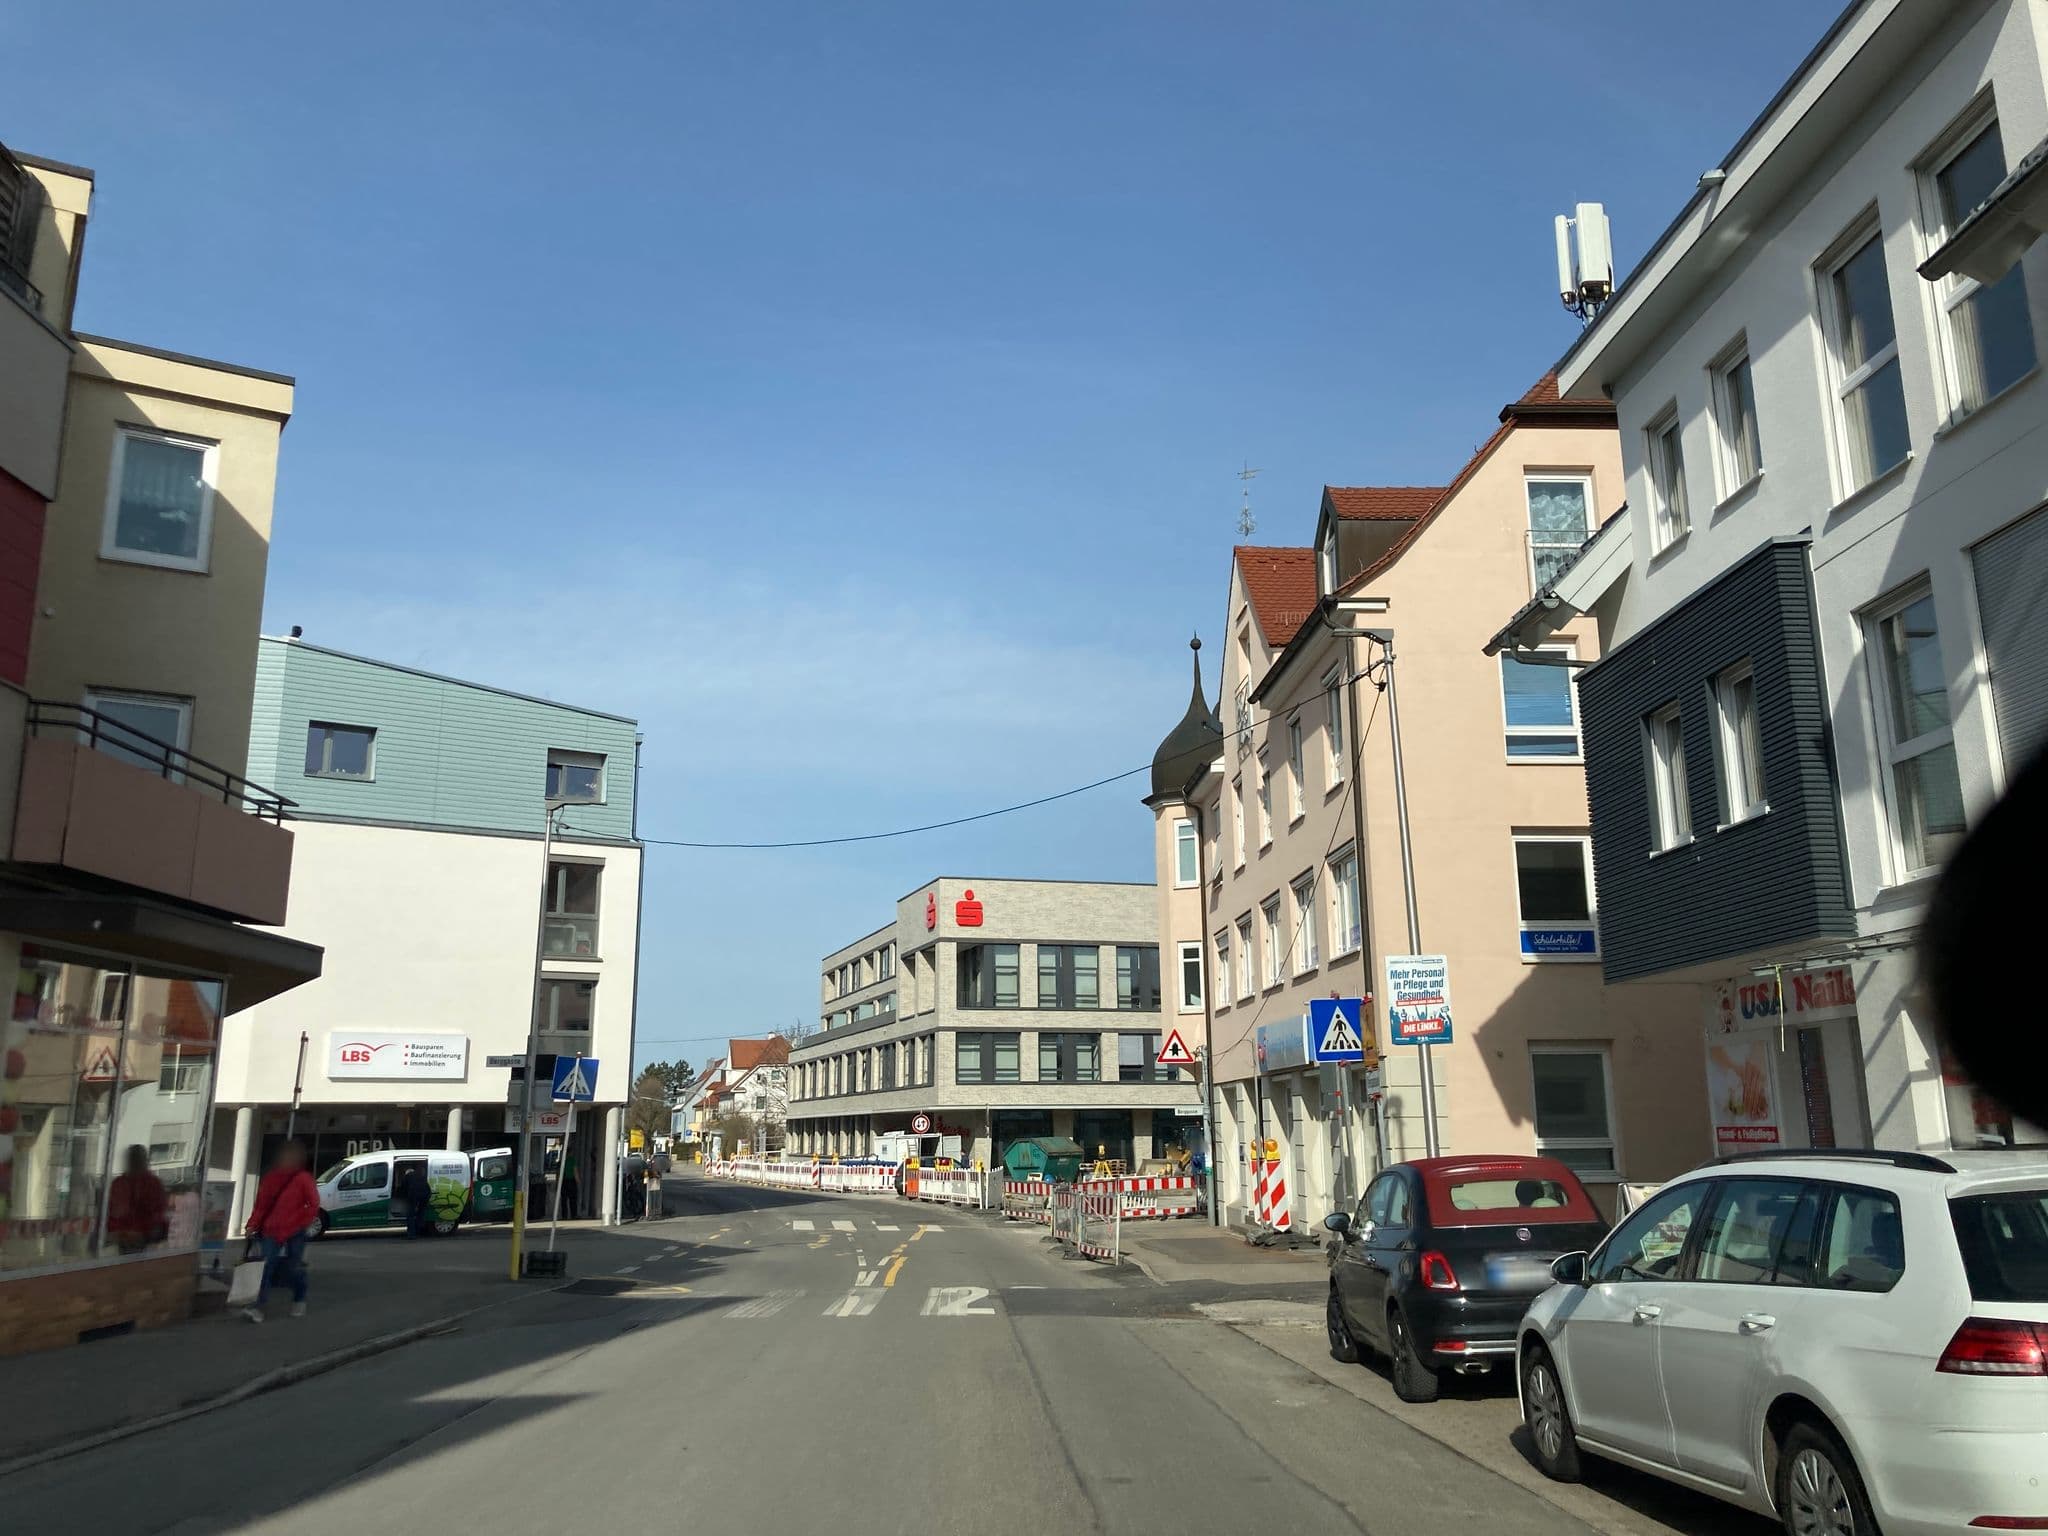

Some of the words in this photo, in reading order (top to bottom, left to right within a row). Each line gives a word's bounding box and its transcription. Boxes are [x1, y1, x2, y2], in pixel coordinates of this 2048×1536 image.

[1390, 969, 1410, 980] Mehr
[1411, 968, 1445, 978] Personal
[1393, 981, 1402, 990] in
[1403, 980, 1428, 990] Pflege
[1429, 978, 1444, 988] und
[1397, 989, 1441, 1001] Gesundheit
[1739, 981, 1788, 1020] USA
[1403, 1023, 1417, 1033] DIE
[411, 1043, 444, 1051] Bausparen
[341, 1050, 371, 1062] LBS
[410, 1052, 462, 1060] Baufinanzierung
[541, 1116, 560, 1125] LBS
